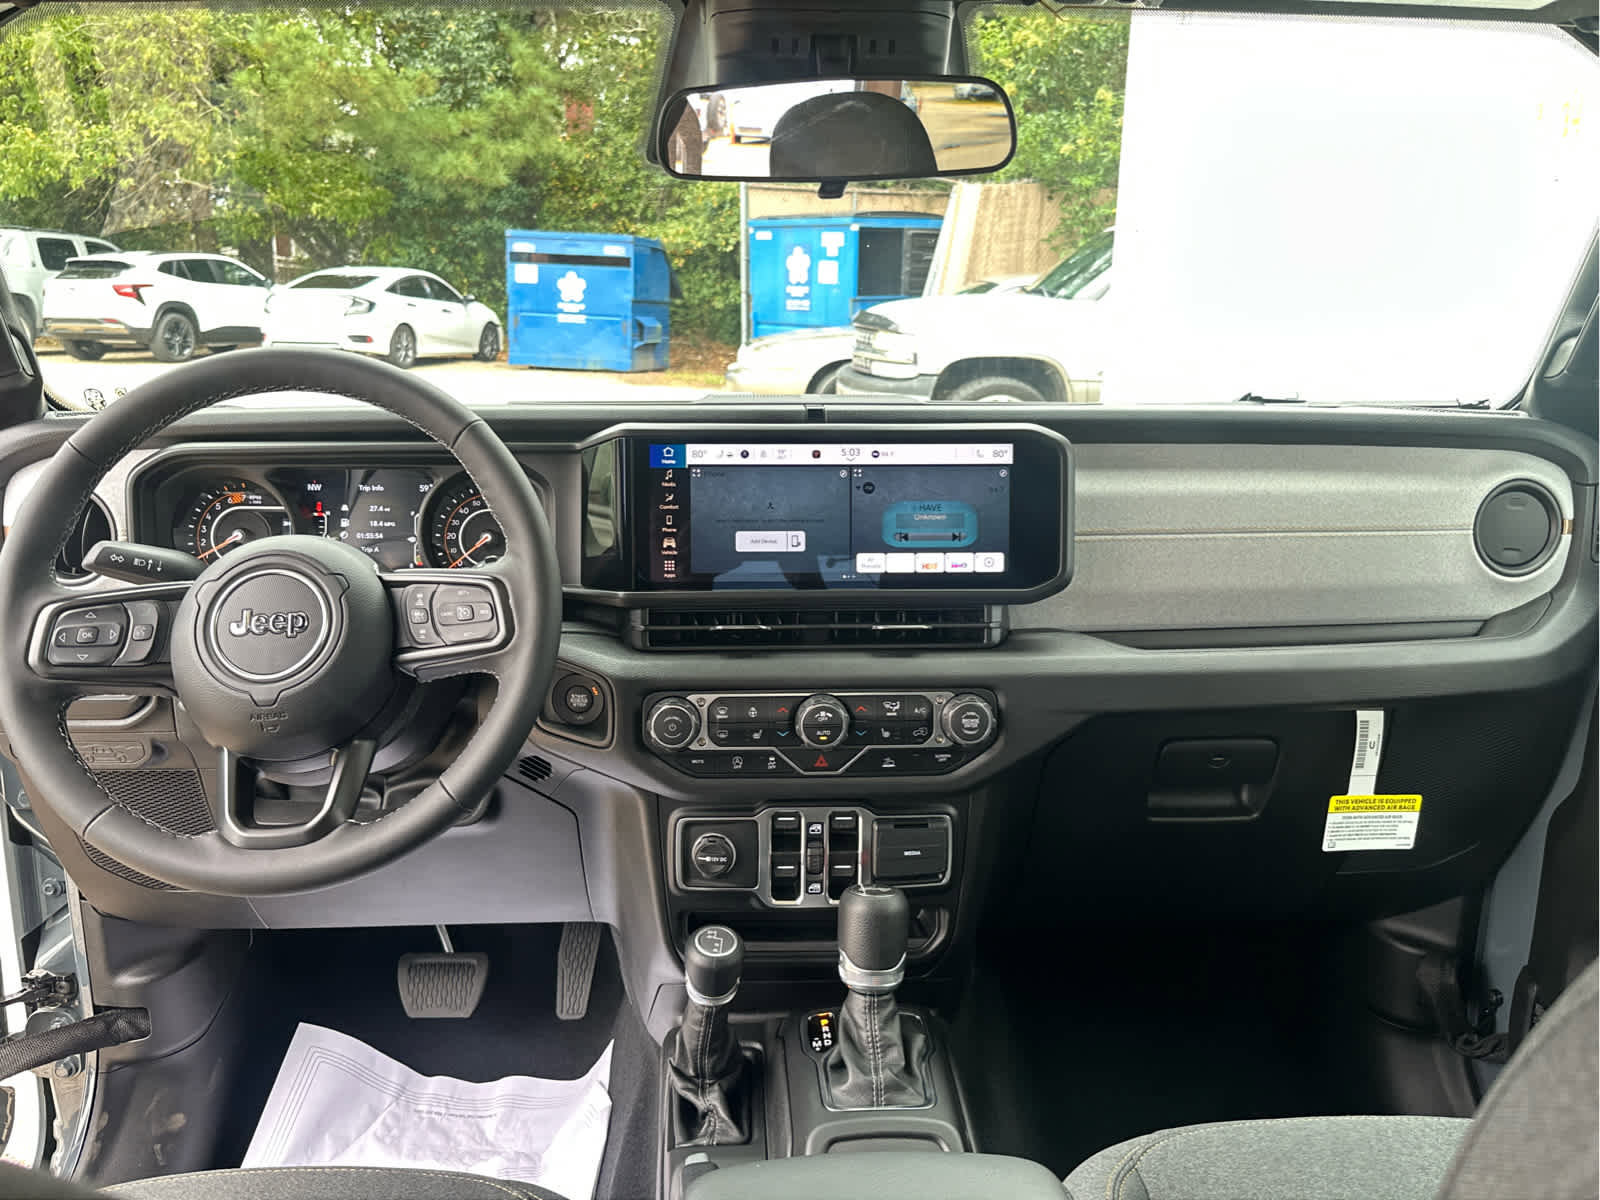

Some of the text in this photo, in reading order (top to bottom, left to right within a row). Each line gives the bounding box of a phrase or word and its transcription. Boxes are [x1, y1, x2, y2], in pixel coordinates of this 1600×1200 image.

[841, 448, 861, 457] 5:03
[307, 483, 322, 491] NW
[919, 503, 943, 512] HAVE
[201, 525, 207, 533] 3
[447, 532, 456, 540] 20
[229, 608, 309, 638] Jeep
[81, 631, 93, 639] OK
[250, 711, 288, 720] AIRBAG
[812, 1040, 822, 1048] M
